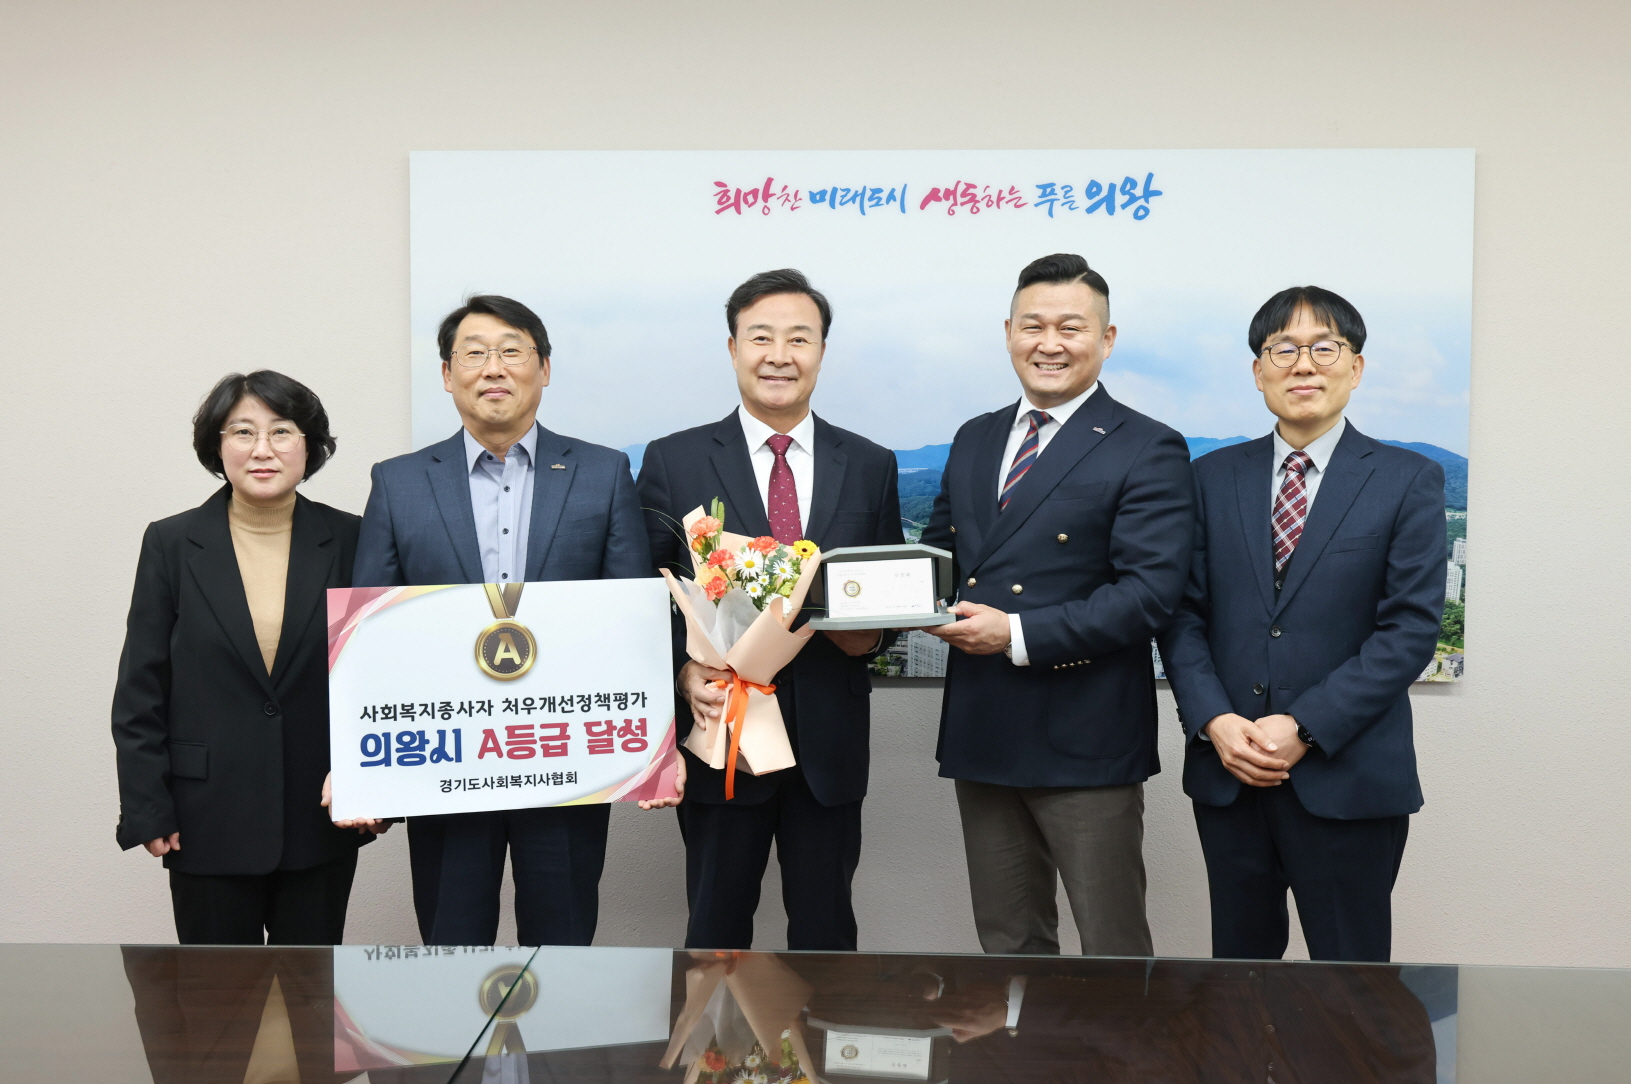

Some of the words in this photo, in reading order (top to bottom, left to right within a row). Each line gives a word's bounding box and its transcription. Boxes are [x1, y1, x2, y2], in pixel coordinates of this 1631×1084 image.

[714, 176, 803, 216] 희망찬
[808, 184, 907, 217] 미래도시
[919, 180, 1028, 216] 생동하는
[1034, 183, 1080, 218] 푸른
[1084, 172, 1164, 221] 의왕
[493, 632, 522, 666] A
[359, 699, 494, 723] 사회복지종사자
[502, 691, 648, 715] 처우개선정책평가
[360, 728, 462, 768] 의왕시
[477, 722, 571, 760] A등급
[584, 717, 649, 755] 달성
[439, 771, 578, 793] 경기도사회복지사협회
